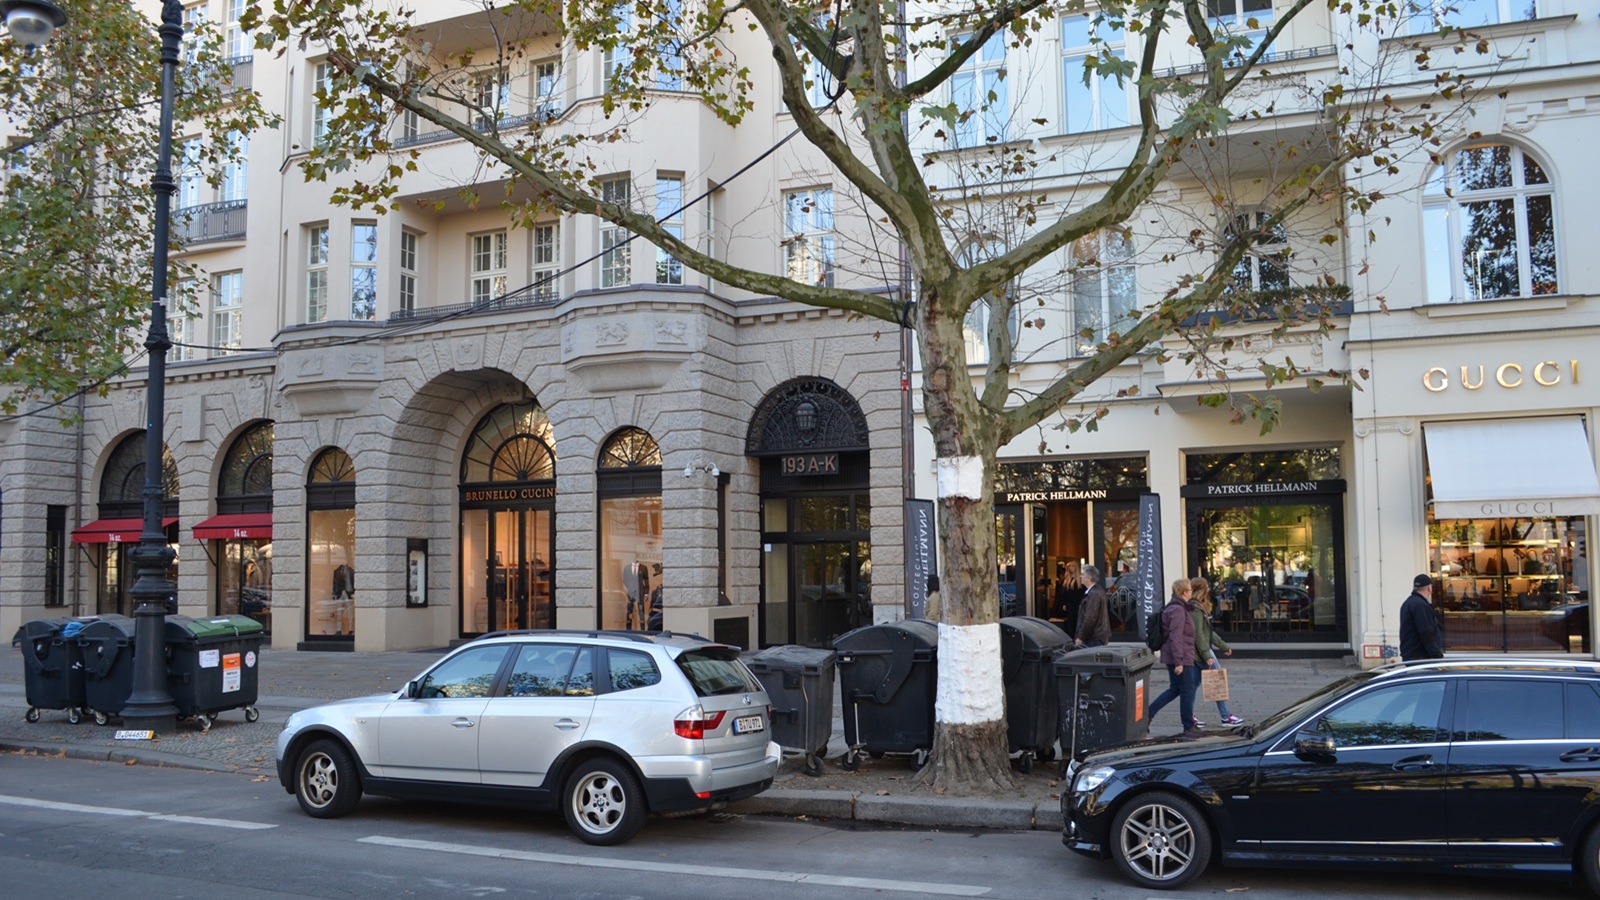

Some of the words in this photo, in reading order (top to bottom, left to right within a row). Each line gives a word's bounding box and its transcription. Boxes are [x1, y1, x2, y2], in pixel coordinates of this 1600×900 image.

[1423, 359, 1579, 392] GUCCI
[782, 456, 805, 473] 193
[808, 455, 836, 472] A-K
[1208, 485, 1253, 494] PATRICK
[1255, 482, 1318, 493] HELLMANN
[466, 489, 517, 501] BRUNELLO
[1007, 492, 1048, 501] PATRICK
[1050, 490, 1107, 500] HELLMANN
[1481, 502, 1554, 515] GUCCI
[109, 534, 115, 542] 14
[234, 529, 240, 537] 14
